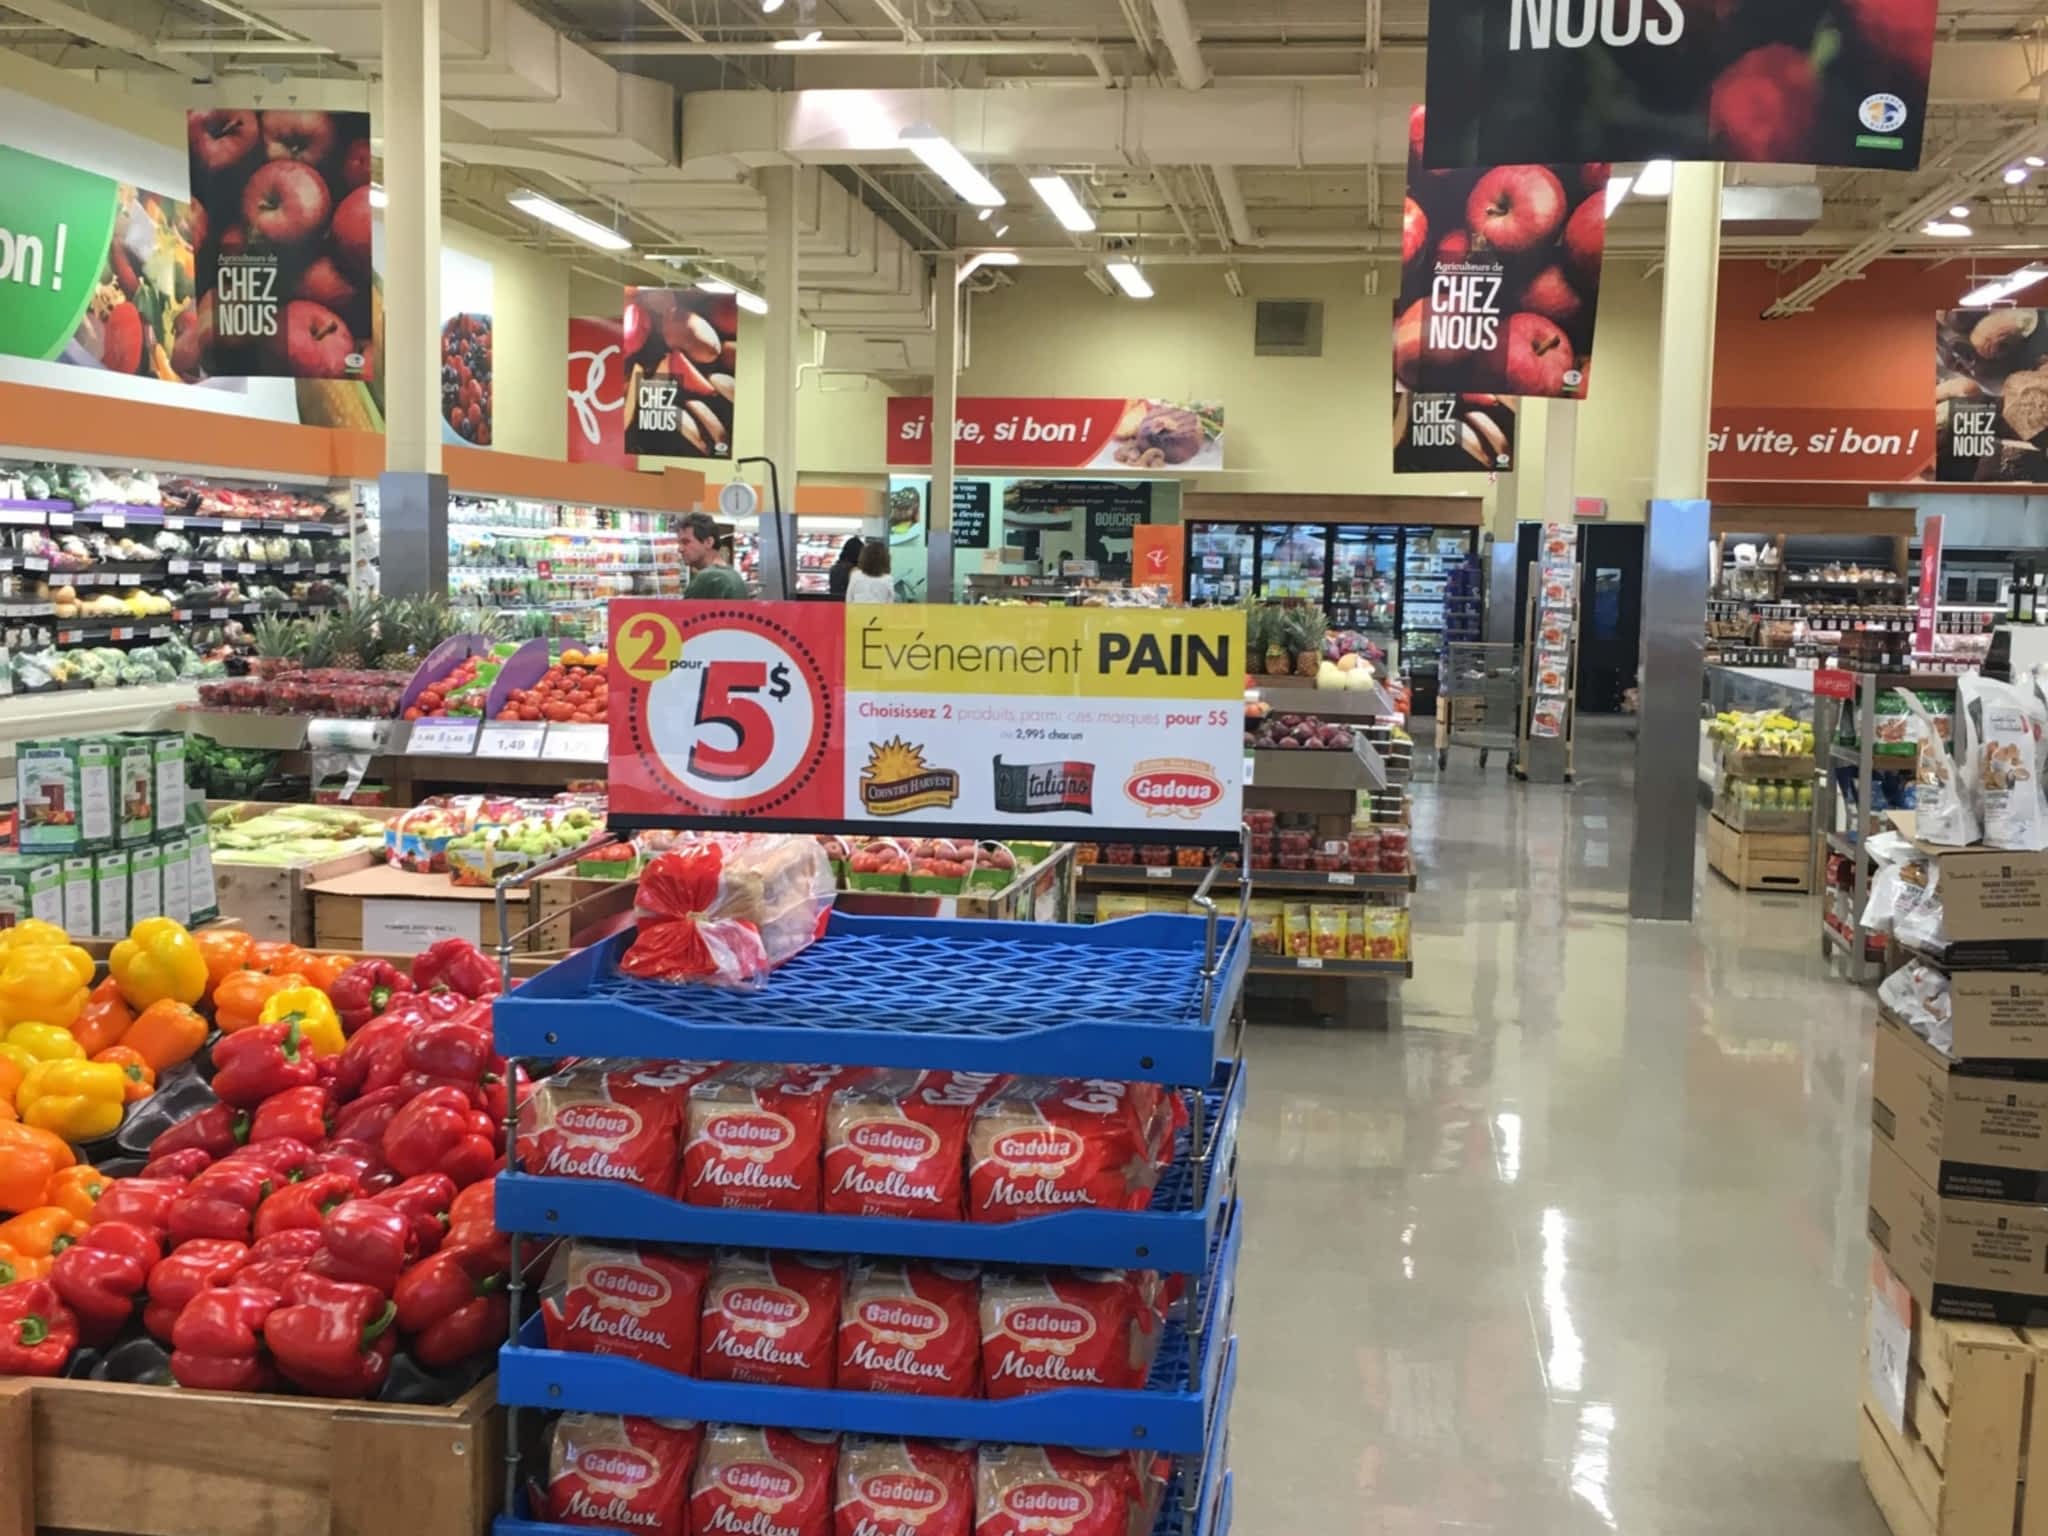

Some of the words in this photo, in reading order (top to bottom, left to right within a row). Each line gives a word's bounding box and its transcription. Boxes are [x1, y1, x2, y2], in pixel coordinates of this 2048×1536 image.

[1492, 262, 1504, 272] de
[218, 268, 278, 301] CHEZ
[1432, 276, 1502, 313] CHEZ
[219, 304, 278, 336] NOUS
[1428, 316, 1499, 350] NOUS
[639, 387, 677, 409] CHEZ
[639, 410, 677, 431] NOUS
[1412, 400, 1456, 423] CHEZ
[1953, 412, 1995, 435] CHEZ
[901, 416, 925, 440] si
[993, 417, 1020, 441] si
[1022, 416, 1077, 442] bon
[1412, 424, 1456, 446] NOUS
[1707, 427, 1730, 451] si
[1736, 428, 1798, 456] vite,
[1807, 428, 1837, 452] si
[1840, 428, 1900, 454] bon
[1953, 436, 1995, 456] NOUS
[1095, 512, 1142, 527] BOUCHER
[629, 619, 667, 671] 2
[669, 659, 703, 670] pour
[861, 616, 1082, 673] Événement
[1097, 632, 1229, 677] PAIN
[858, 702, 936, 720] Choisissez
[942, 704, 952, 719] 2
[957, 706, 1015, 724] produits
[1166, 712, 1202, 728] pour
[1207, 710, 1228, 726] 5$
[1048, 730, 1083, 740] chacun
[1136, 779, 1212, 799] Gadoua
[562, 1110, 629, 1133] Gadoua
[714, 1121, 781, 1141] Gadoua
[855, 1128, 925, 1151] Gadoua
[1001, 1138, 1070, 1156] Gadoua
[539, 1145, 645, 1183] Moelleux
[692, 1158, 802, 1190] Moelleux
[832, 1165, 942, 1203] Moelleux
[982, 1177, 1096, 1209] Moelleux
[593, 1270, 659, 1298] Gadoua
[729, 1292, 796, 1318] Gadoua
[866, 1304, 935, 1330] Gadoua
[567, 1305, 672, 1350] Moelleux
[1012, 1312, 1082, 1334] Gadoua
[706, 1329, 811, 1369] Moelleux
[843, 1340, 952, 1381] Moelleux
[992, 1350, 1104, 1384] Moelleux
[584, 1453, 648, 1480] Gadoua
[727, 1467, 791, 1494] Gadoua
[868, 1480, 935, 1504] Gadoua
[560, 1490, 662, 1527] Moelleux
[1012, 1490, 1080, 1512] Gadoua
